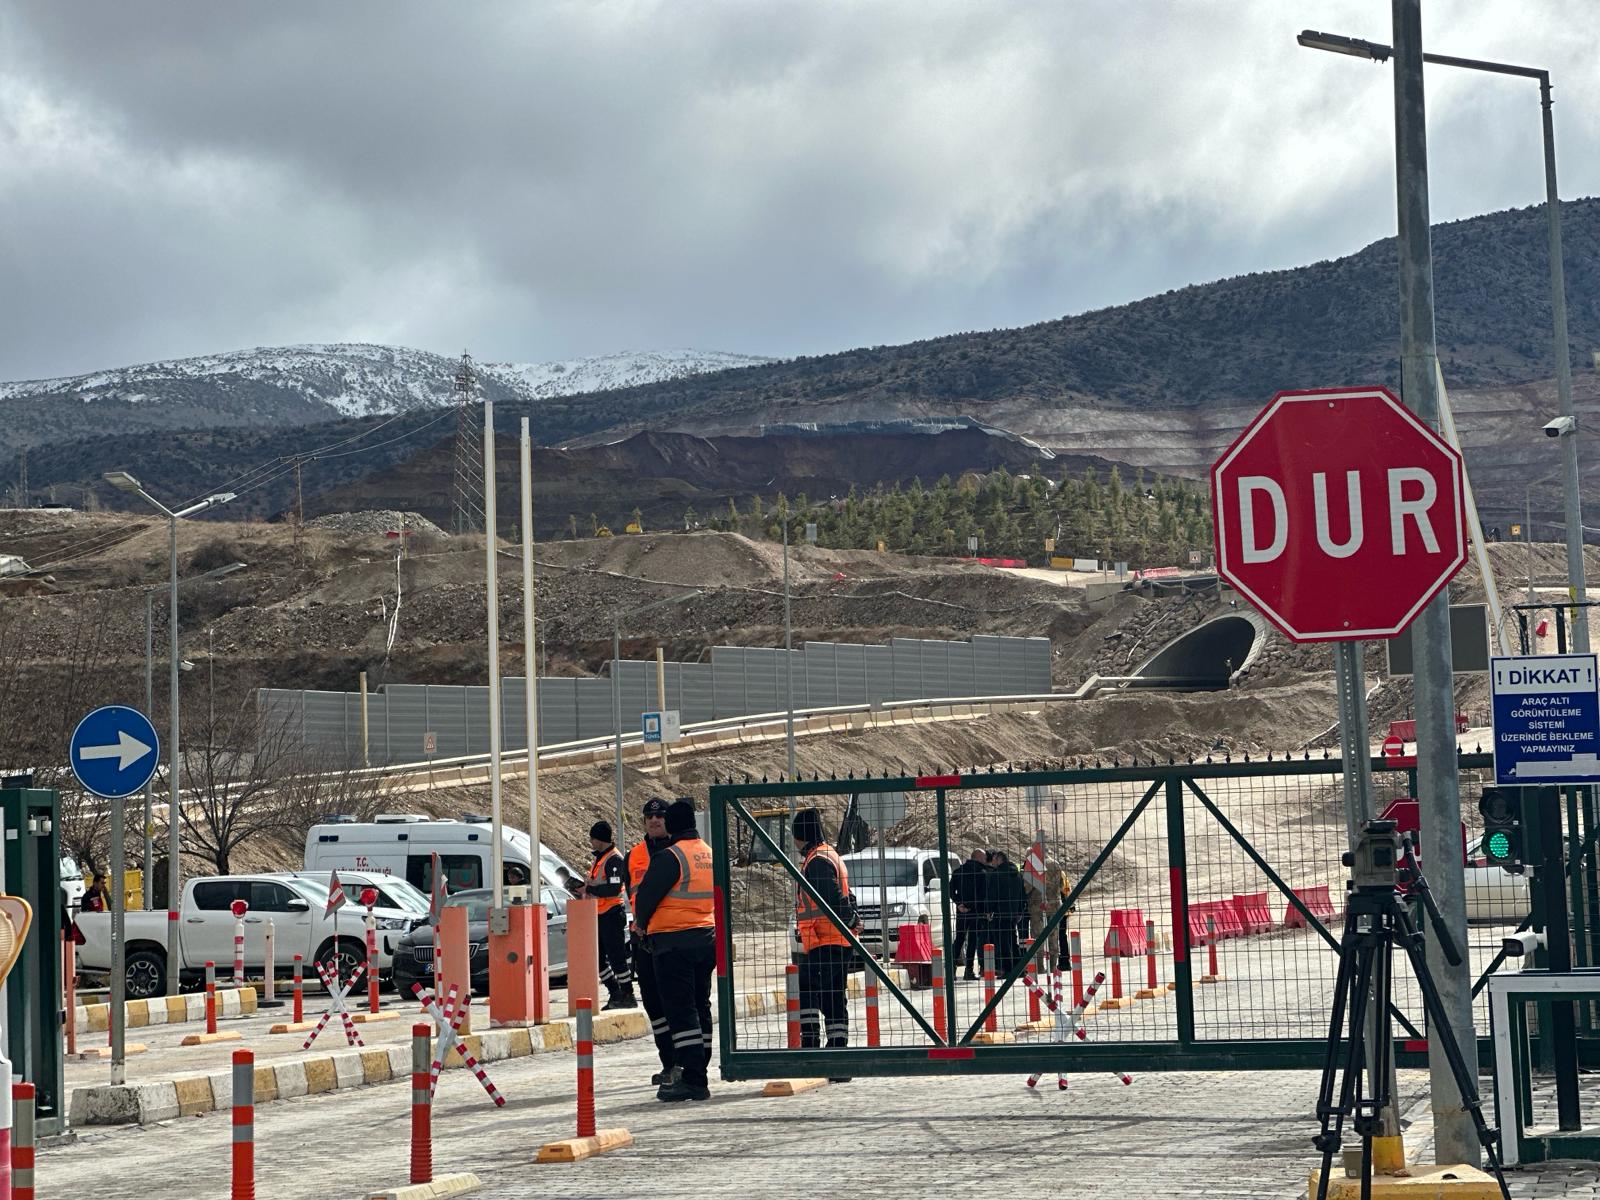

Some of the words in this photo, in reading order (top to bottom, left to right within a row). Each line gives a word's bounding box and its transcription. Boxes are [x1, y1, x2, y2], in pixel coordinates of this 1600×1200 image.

[1238, 467, 1440, 564] DUR
[1510, 667, 1580, 685] DİKKAT
[1522, 698, 1548, 706] ARAÇ
[1511, 709, 1582, 718] GÖRÜNTÜLEME
[1528, 720, 1565, 729] SİSTEMİ
[1501, 732, 1547, 742] ÜZERİNDE
[1550, 732, 1594, 740] BEKLEME
[356, 858, 368, 867] T.C.
